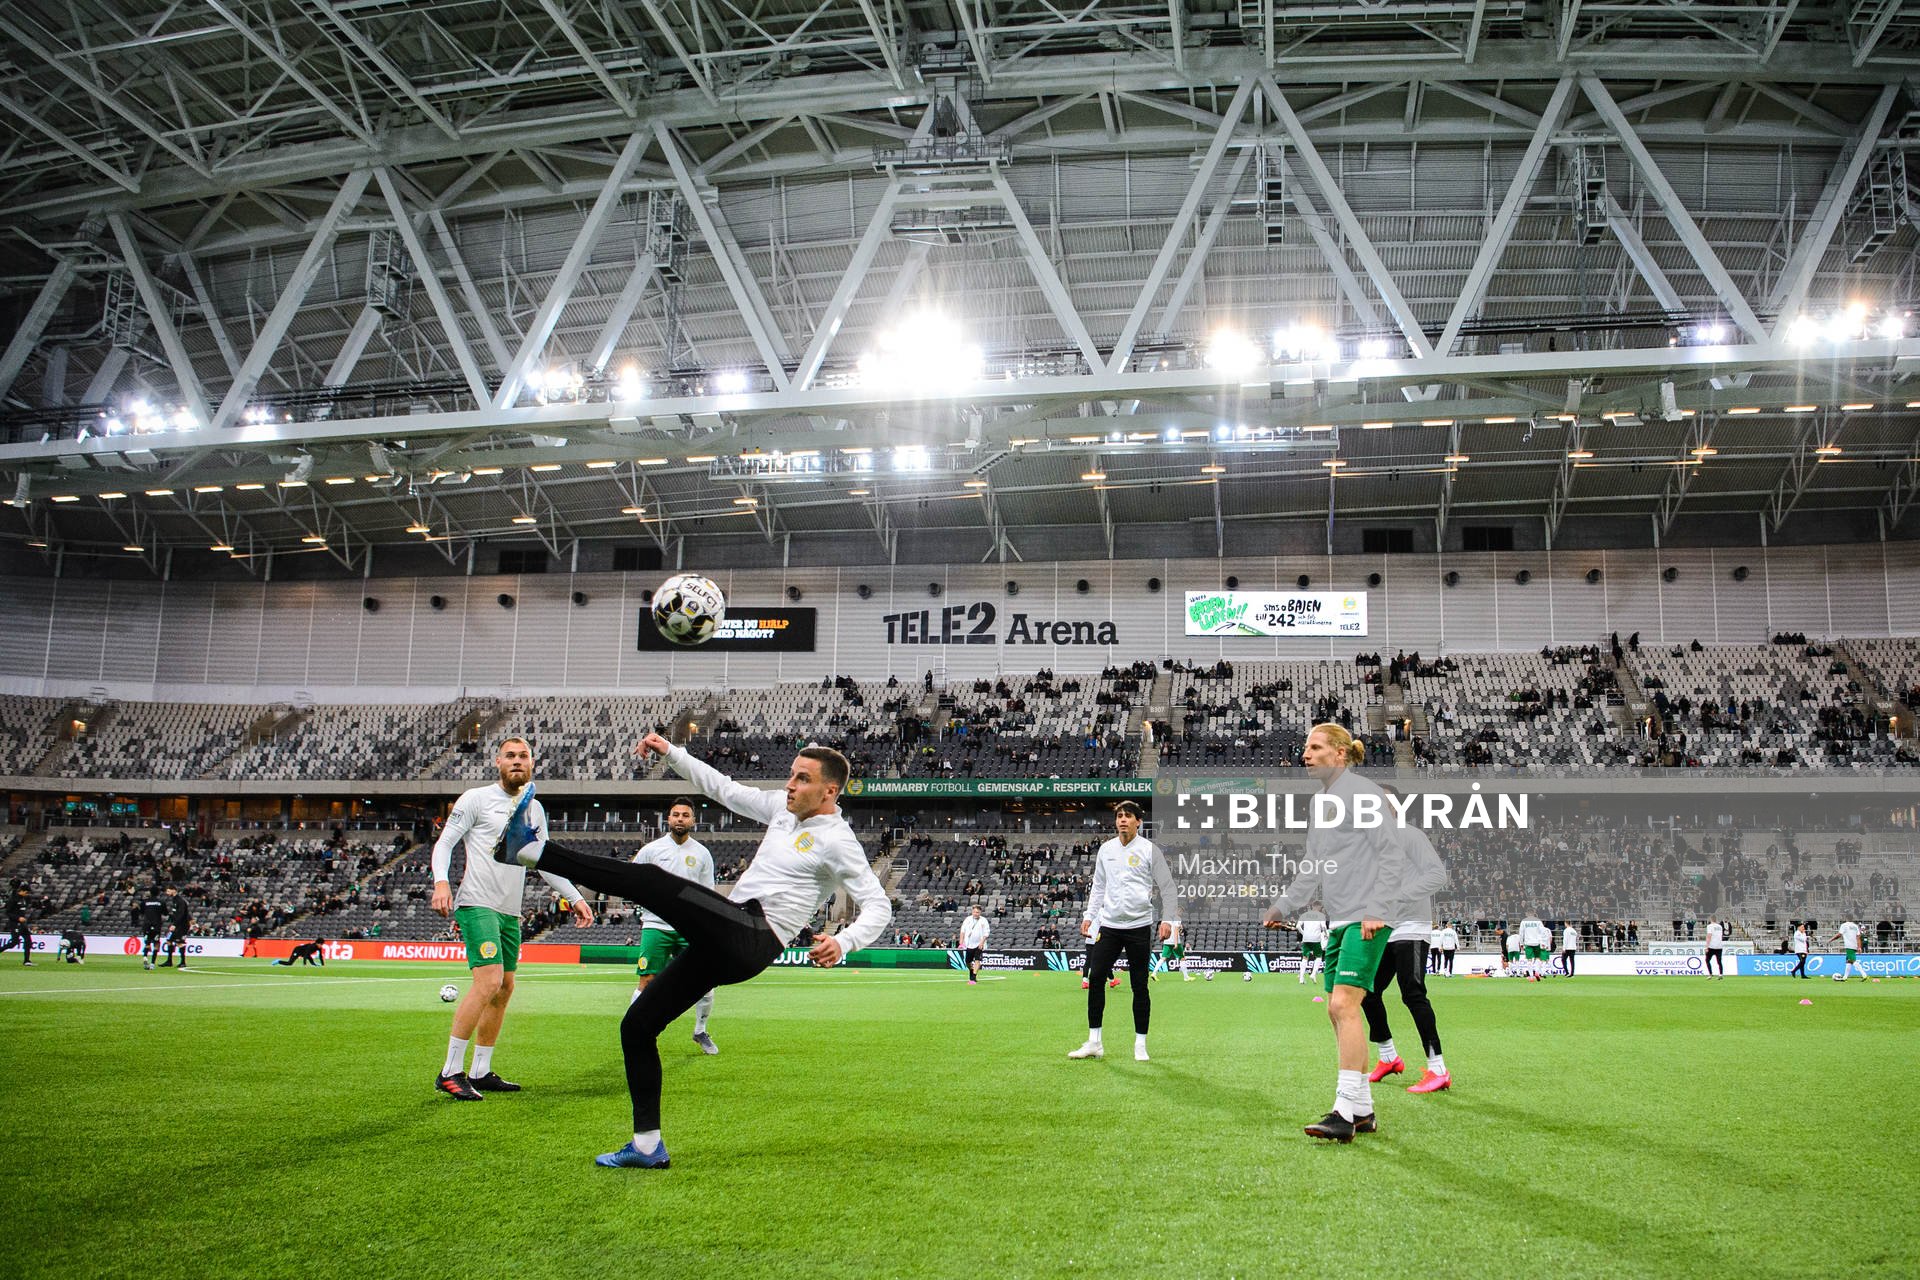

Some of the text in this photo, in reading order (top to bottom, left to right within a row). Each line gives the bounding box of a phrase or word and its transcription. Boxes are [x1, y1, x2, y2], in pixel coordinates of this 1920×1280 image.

[685, 582, 718, 608] SELECT
[1288, 599, 1321, 614] BAJEN
[883, 601, 1119, 645] TELE2 Arena
[1268, 613, 1296, 627] 242
[1340, 622, 1360, 631] TELE2
[867, 781, 1152, 793] HAMMARBY FOTBOLL GEMENSKAP RESPEKT KÄRLEK
[975, 955, 1034, 966] asmästeri
